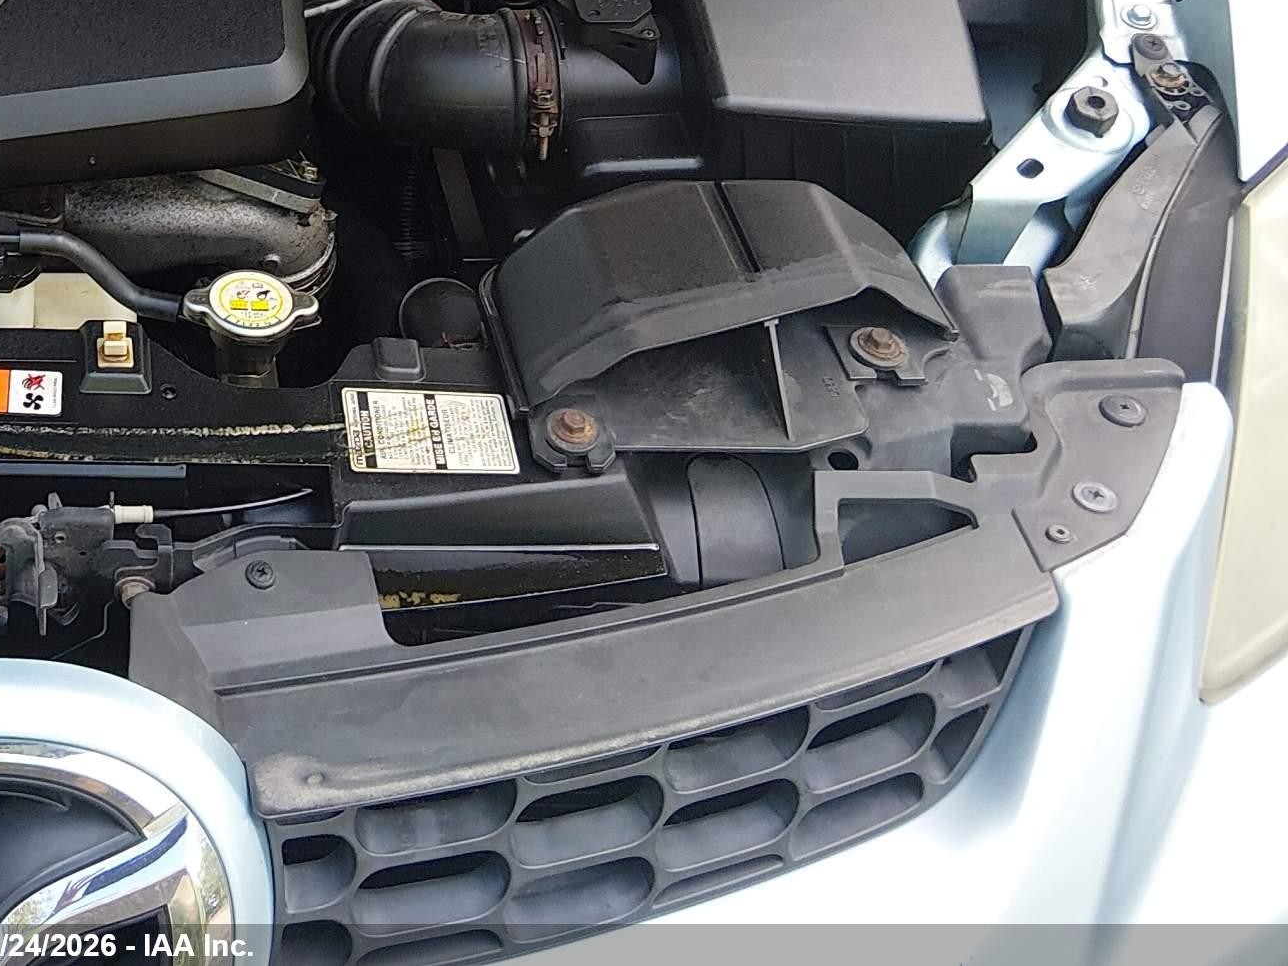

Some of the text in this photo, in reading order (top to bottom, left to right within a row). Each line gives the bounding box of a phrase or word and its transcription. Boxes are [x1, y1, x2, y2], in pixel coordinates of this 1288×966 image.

[360, 410, 374, 450] CAUTION
[373, 400, 385, 445] CONDITIONER
[425, 398, 440, 428] GARDE
[433, 443, 446, 465] MISE
